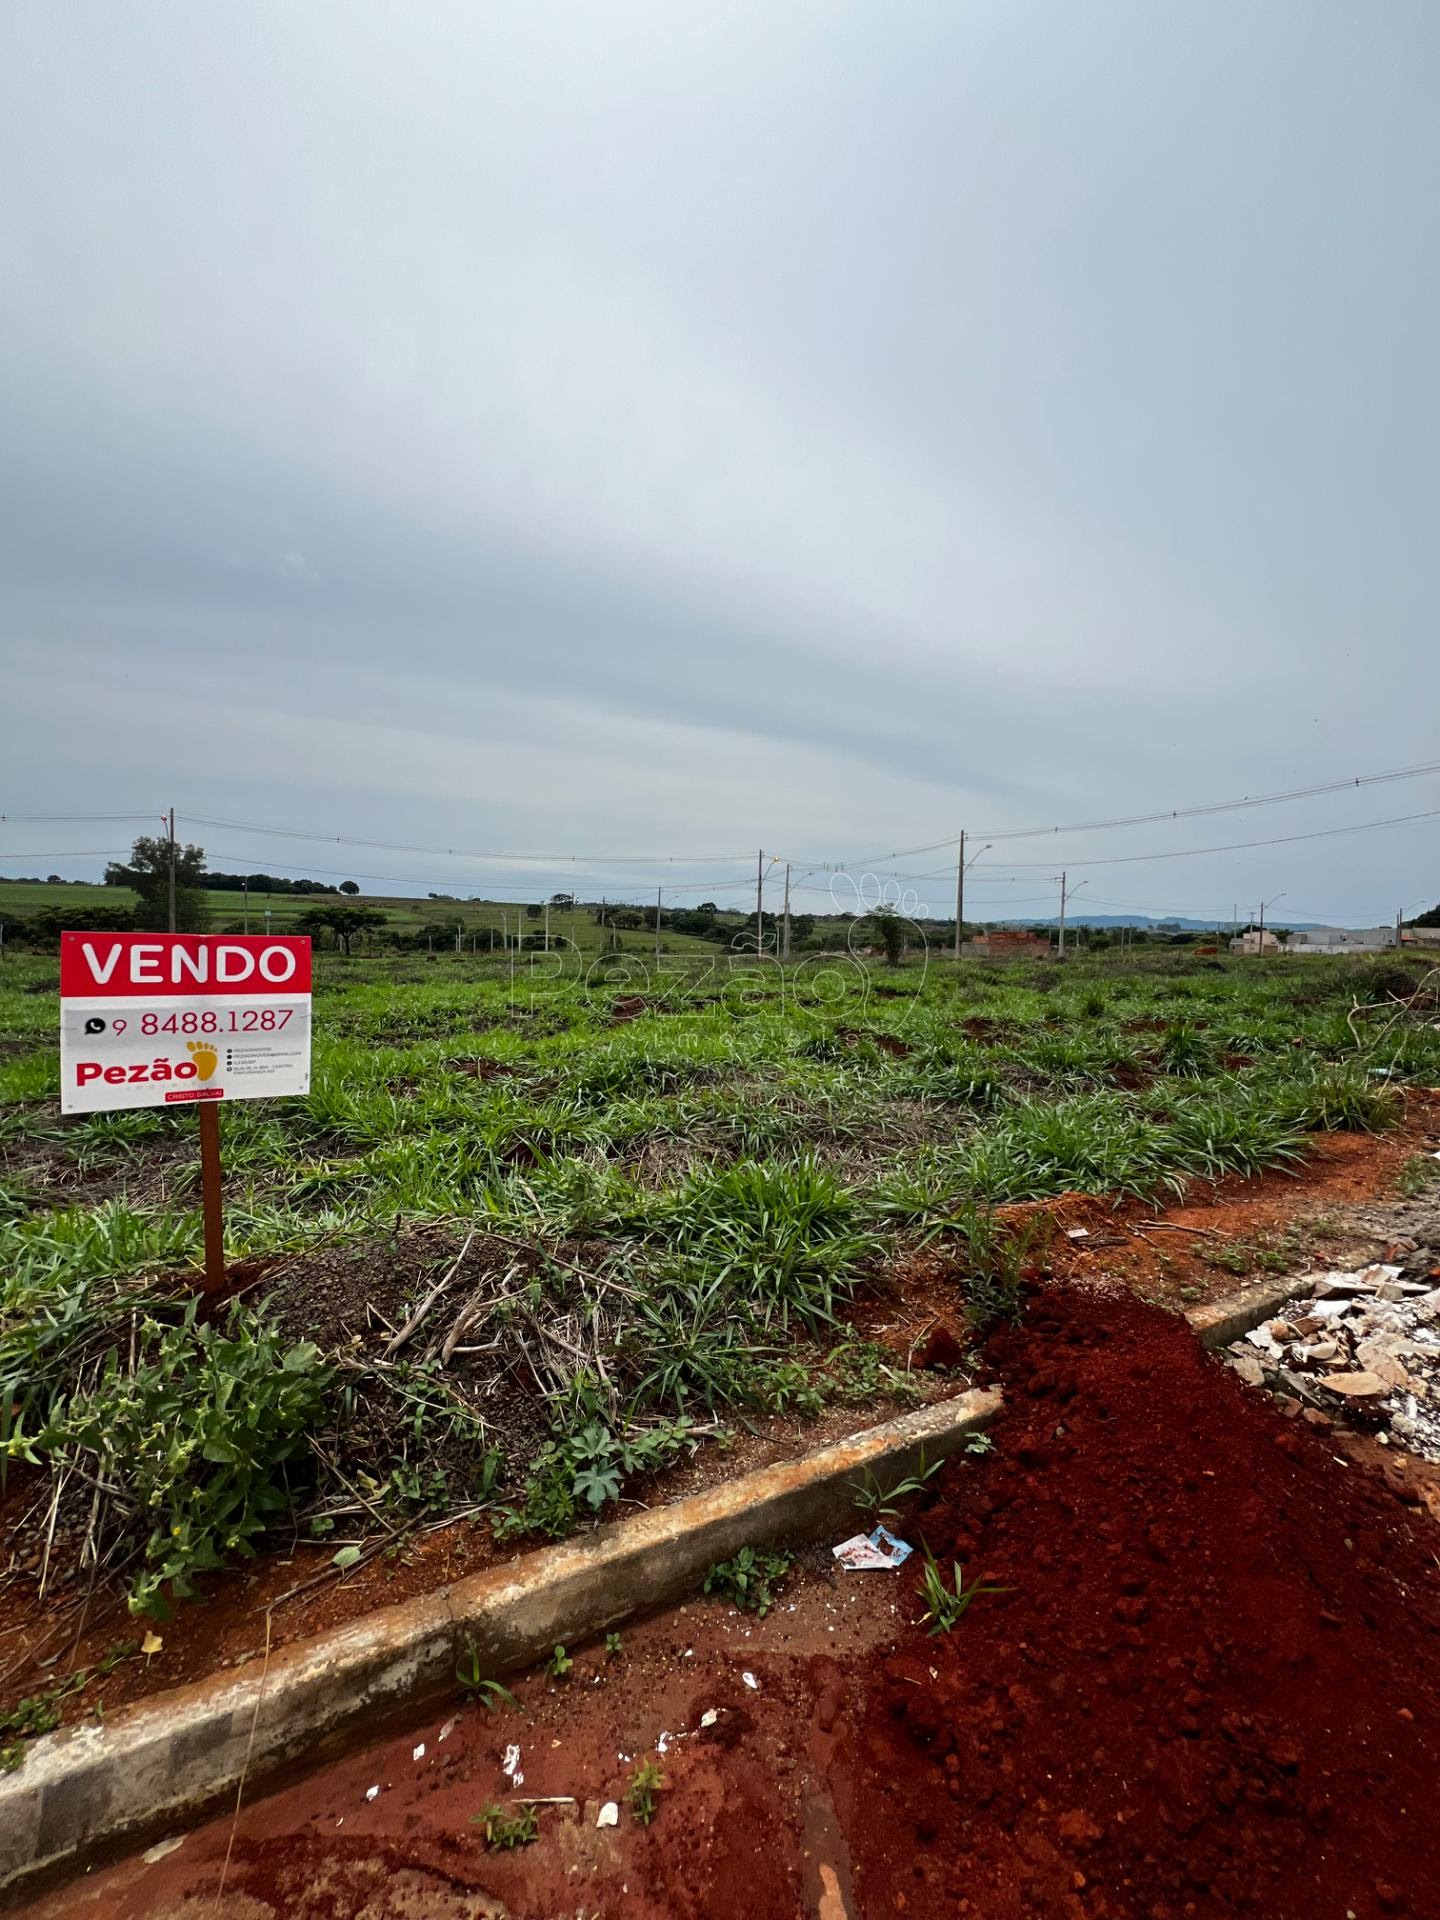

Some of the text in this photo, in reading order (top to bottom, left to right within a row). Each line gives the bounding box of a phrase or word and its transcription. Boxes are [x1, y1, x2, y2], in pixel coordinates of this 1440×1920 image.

[82, 943, 296, 985] VENDO
[112, 1009, 293, 1036] 9 8488.1287
[76, 1057, 198, 1087] Pezão
[167, 1092, 195, 1100] CRISTO
